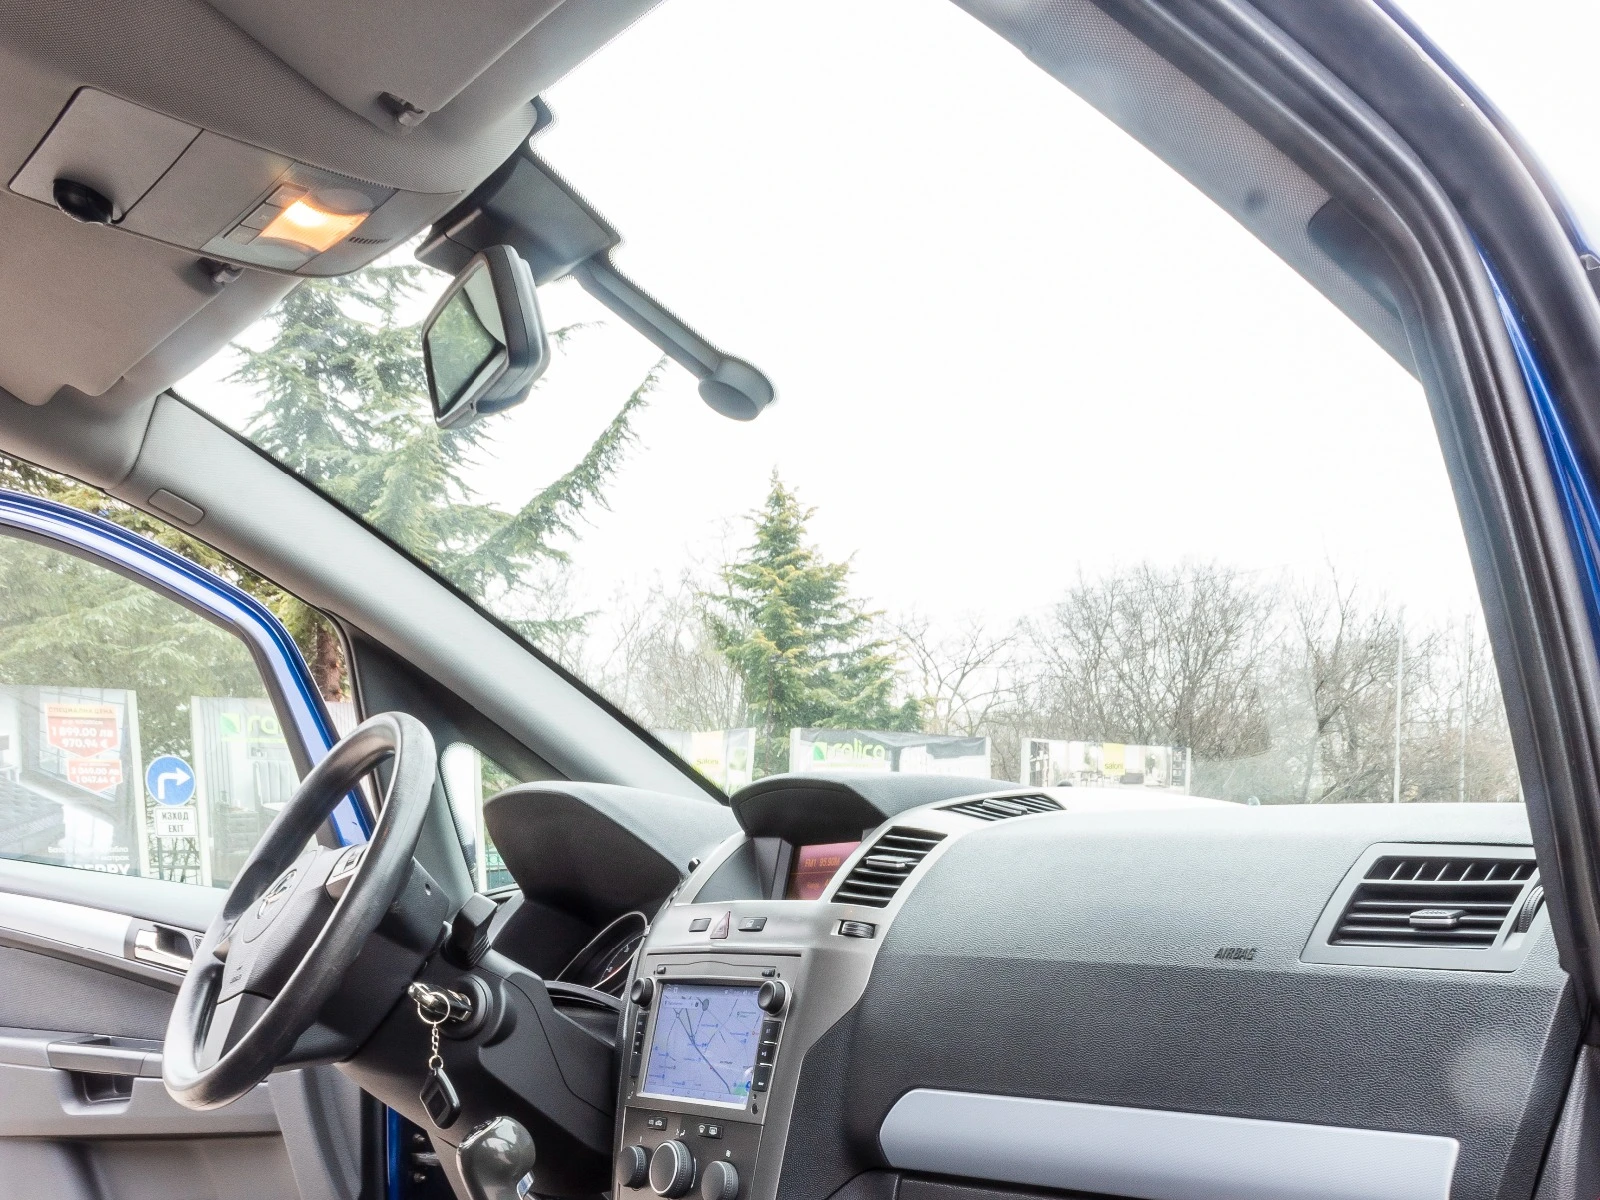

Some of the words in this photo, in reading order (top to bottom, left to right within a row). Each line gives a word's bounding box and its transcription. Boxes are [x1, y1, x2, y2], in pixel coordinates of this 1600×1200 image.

[834, 738, 886, 761] ralica
[161, 811, 189, 821] ИЗХОД
[168, 824, 184, 833] EXIT
[1213, 947, 1257, 961] AIRBAG
